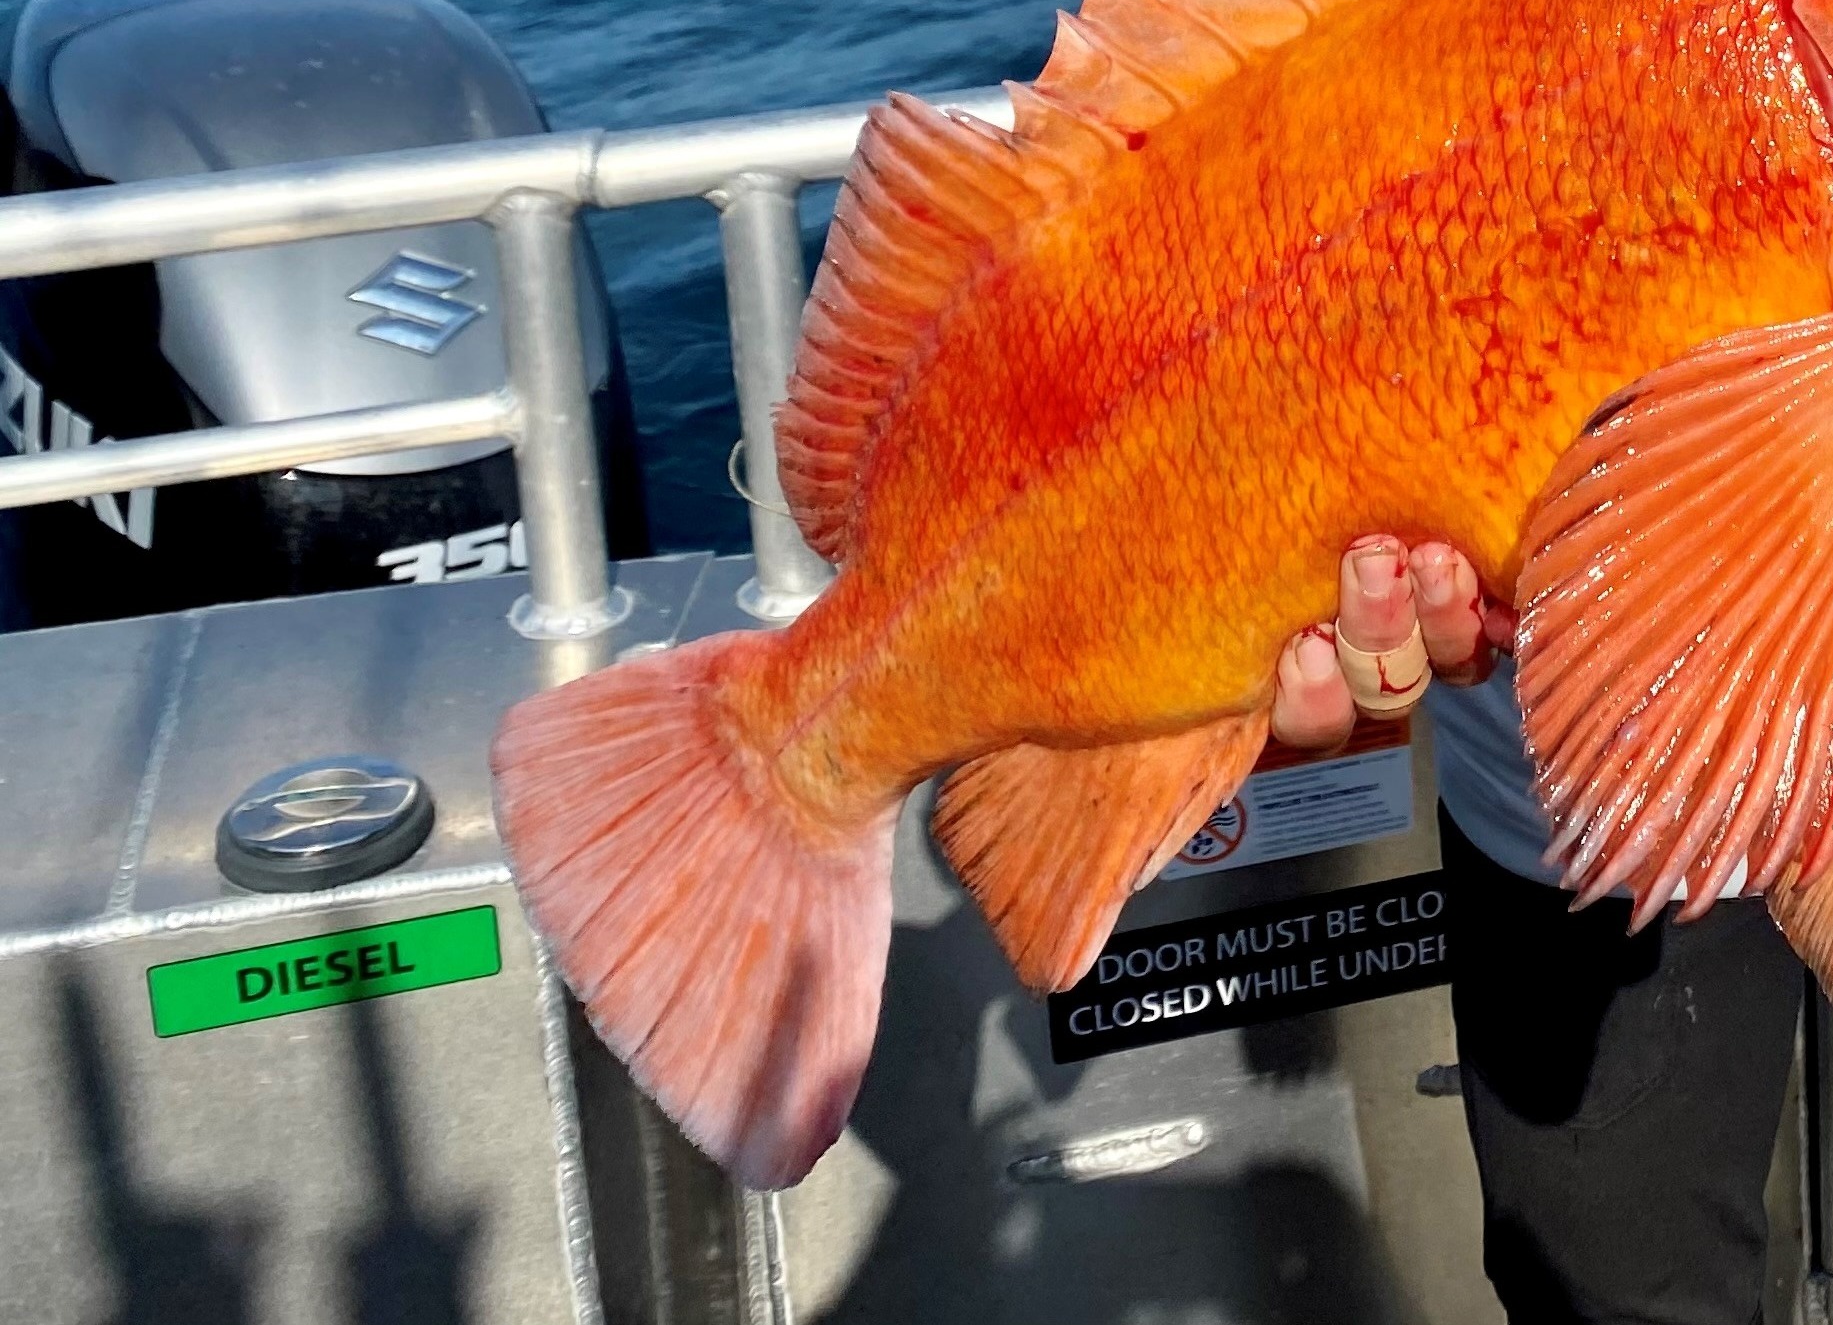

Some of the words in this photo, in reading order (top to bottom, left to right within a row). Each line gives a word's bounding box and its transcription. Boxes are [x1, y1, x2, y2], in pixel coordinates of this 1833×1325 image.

[236, 940, 416, 1004] DIESEL
[1098, 938, 1207, 985] DOOR
[1216, 914, 1317, 961] MUST
[1326, 904, 1368, 939] BE
[1375, 890, 1447, 927] CLO
[1068, 984, 1213, 1036] CLOSED
[1216, 957, 1329, 1006] WHILE
